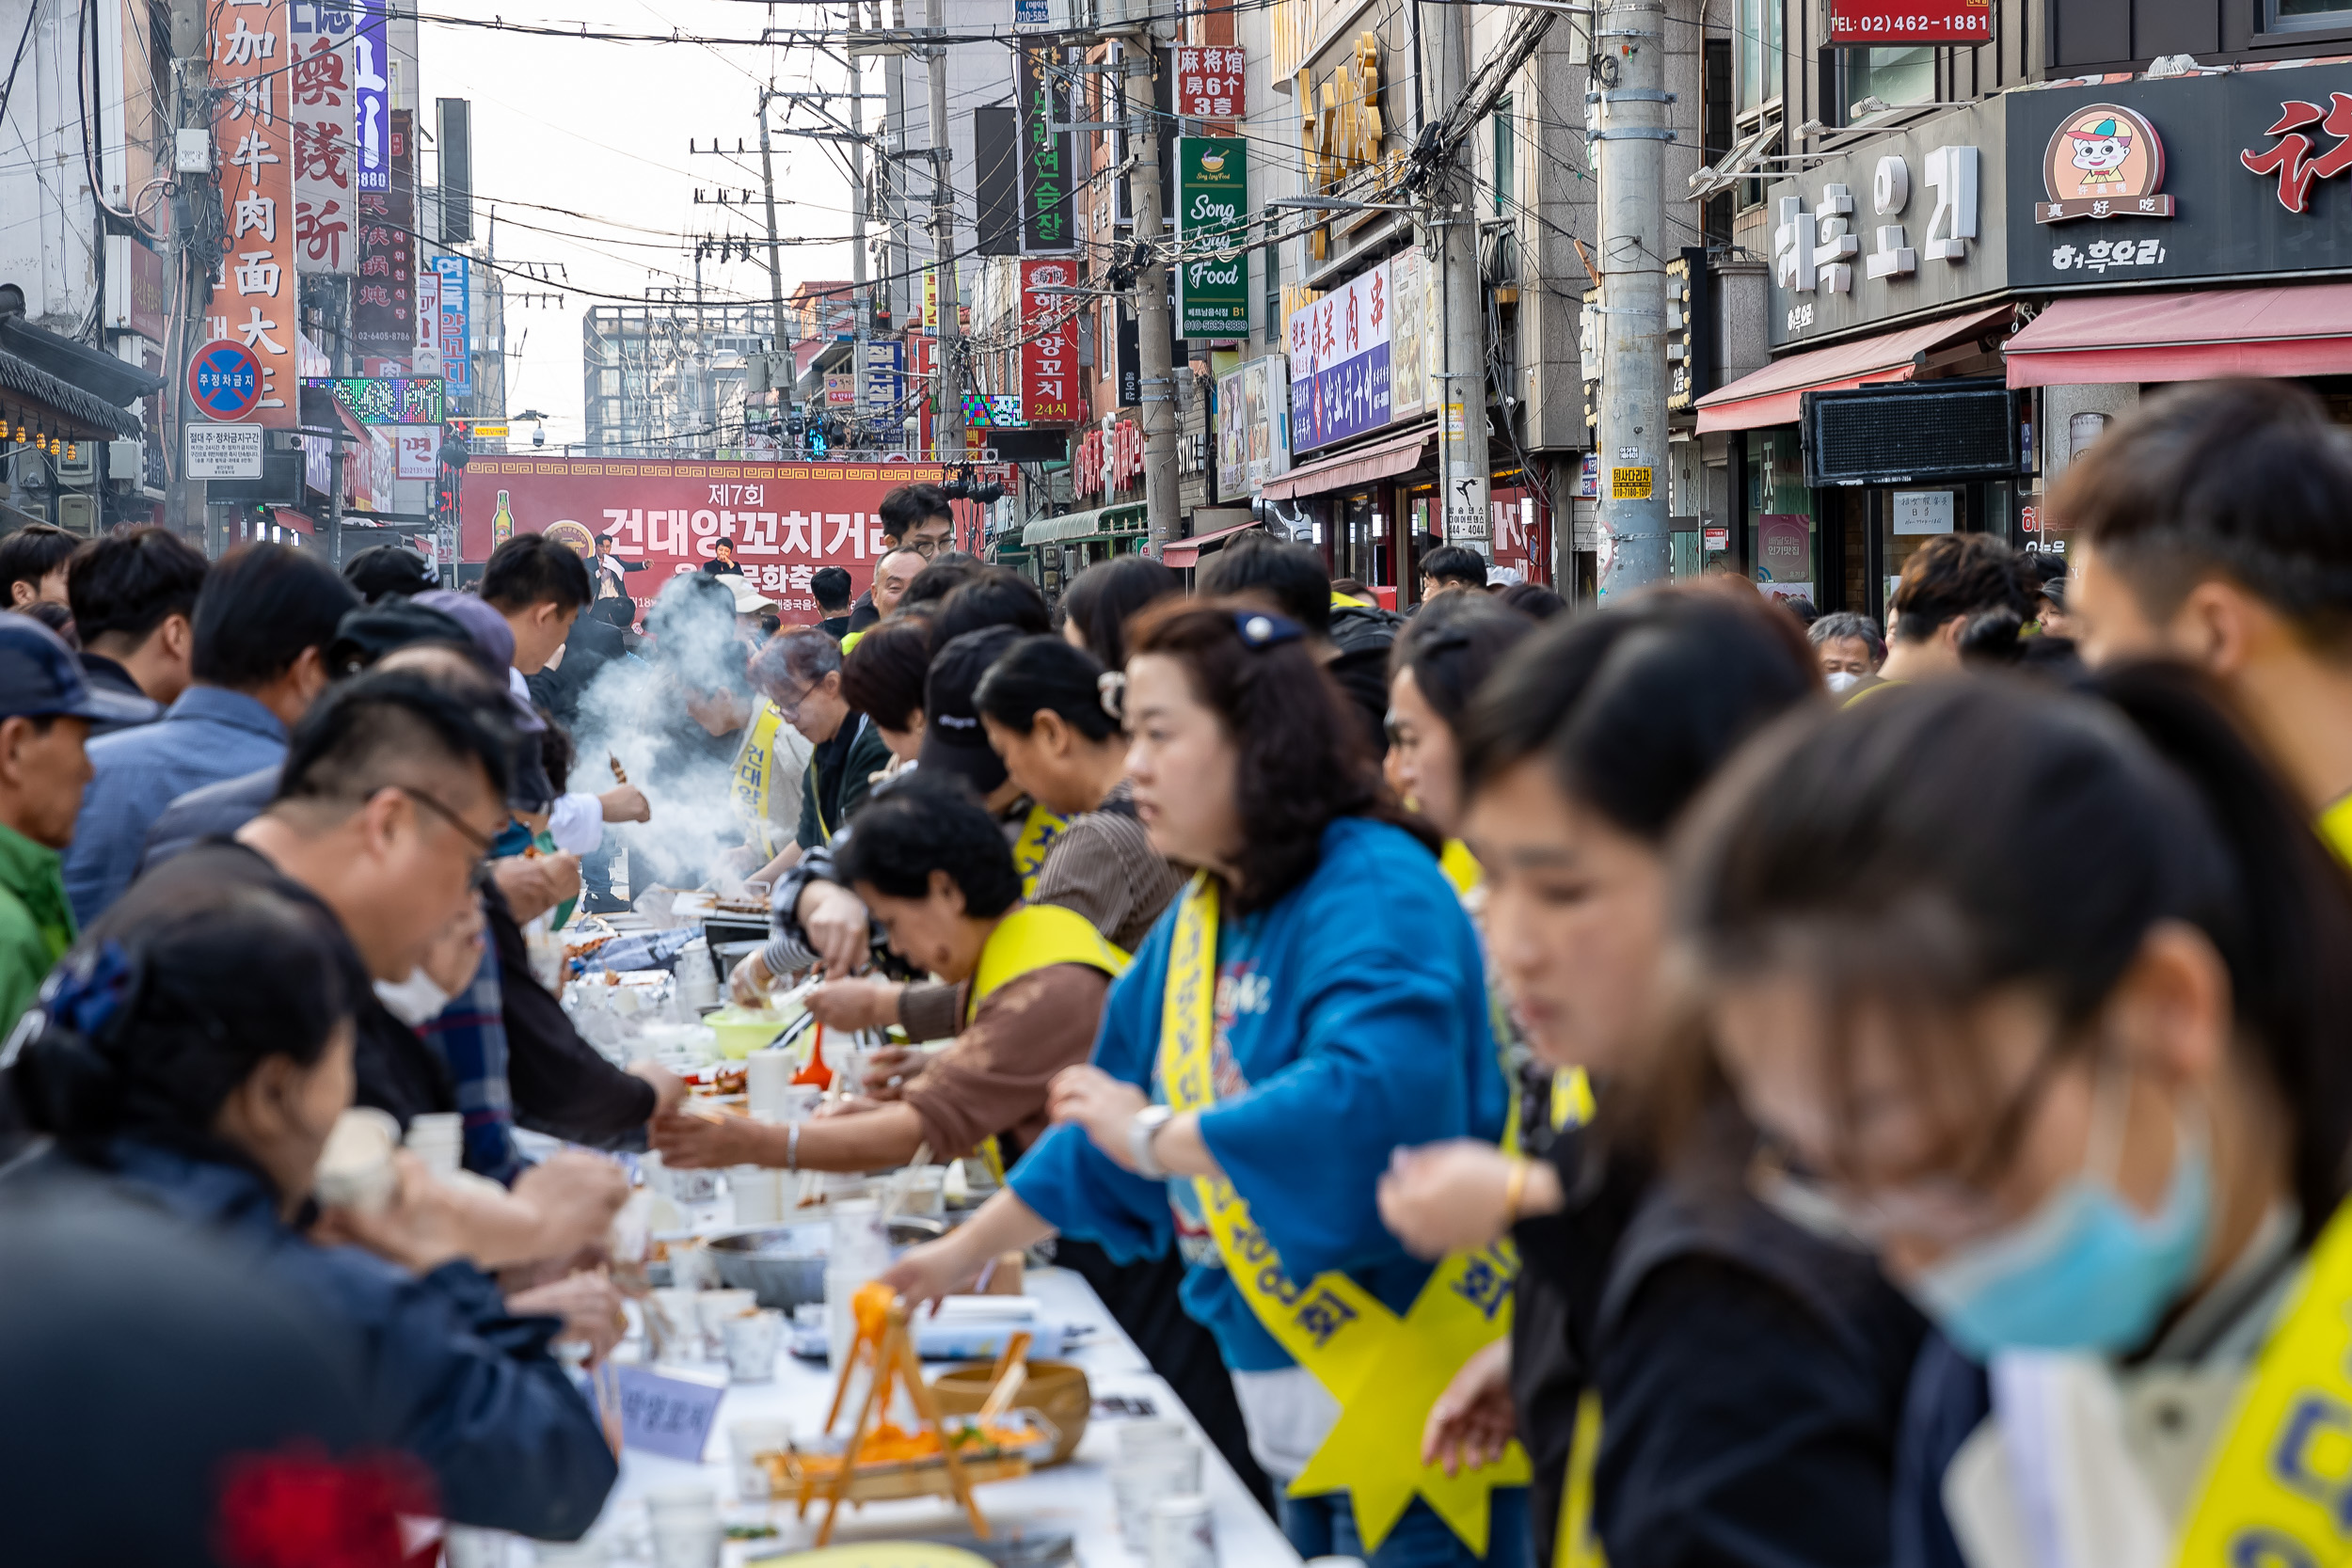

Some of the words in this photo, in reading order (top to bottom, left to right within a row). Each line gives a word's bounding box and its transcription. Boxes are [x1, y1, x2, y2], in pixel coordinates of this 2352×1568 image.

[1831, 17, 1857, 32] TEL:
[1861, 14, 1987, 31] 02)462-1881
[1181, 49, 1246, 75] 麻将馆
[1195, 97, 1233, 115] 3층
[1190, 194, 1235, 226] Song
[2048, 198, 2155, 217] 真好吃
[1774, 145, 1978, 294] 허흑오리
[2052, 240, 2166, 274] 허흑오리
[1190, 261, 1239, 289] Food
[1232, 307, 1245, 317] B1
[1323, 271, 1383, 362] 羊肉串
[358, 331, 410, 341] 02-6405-8786
[199, 372, 254, 388] 주정차금지
[1035, 403, 1067, 416] 24시
[190, 433, 204, 443] 절대
[206, 433, 259, 443] 주·정차금지구간
[1621, 468, 1649, 481] 사다리차
[708, 483, 764, 507] 제7회
[1769, 536, 1799, 546] 배달되는
[1769, 546, 1799, 556] 인기맛집
